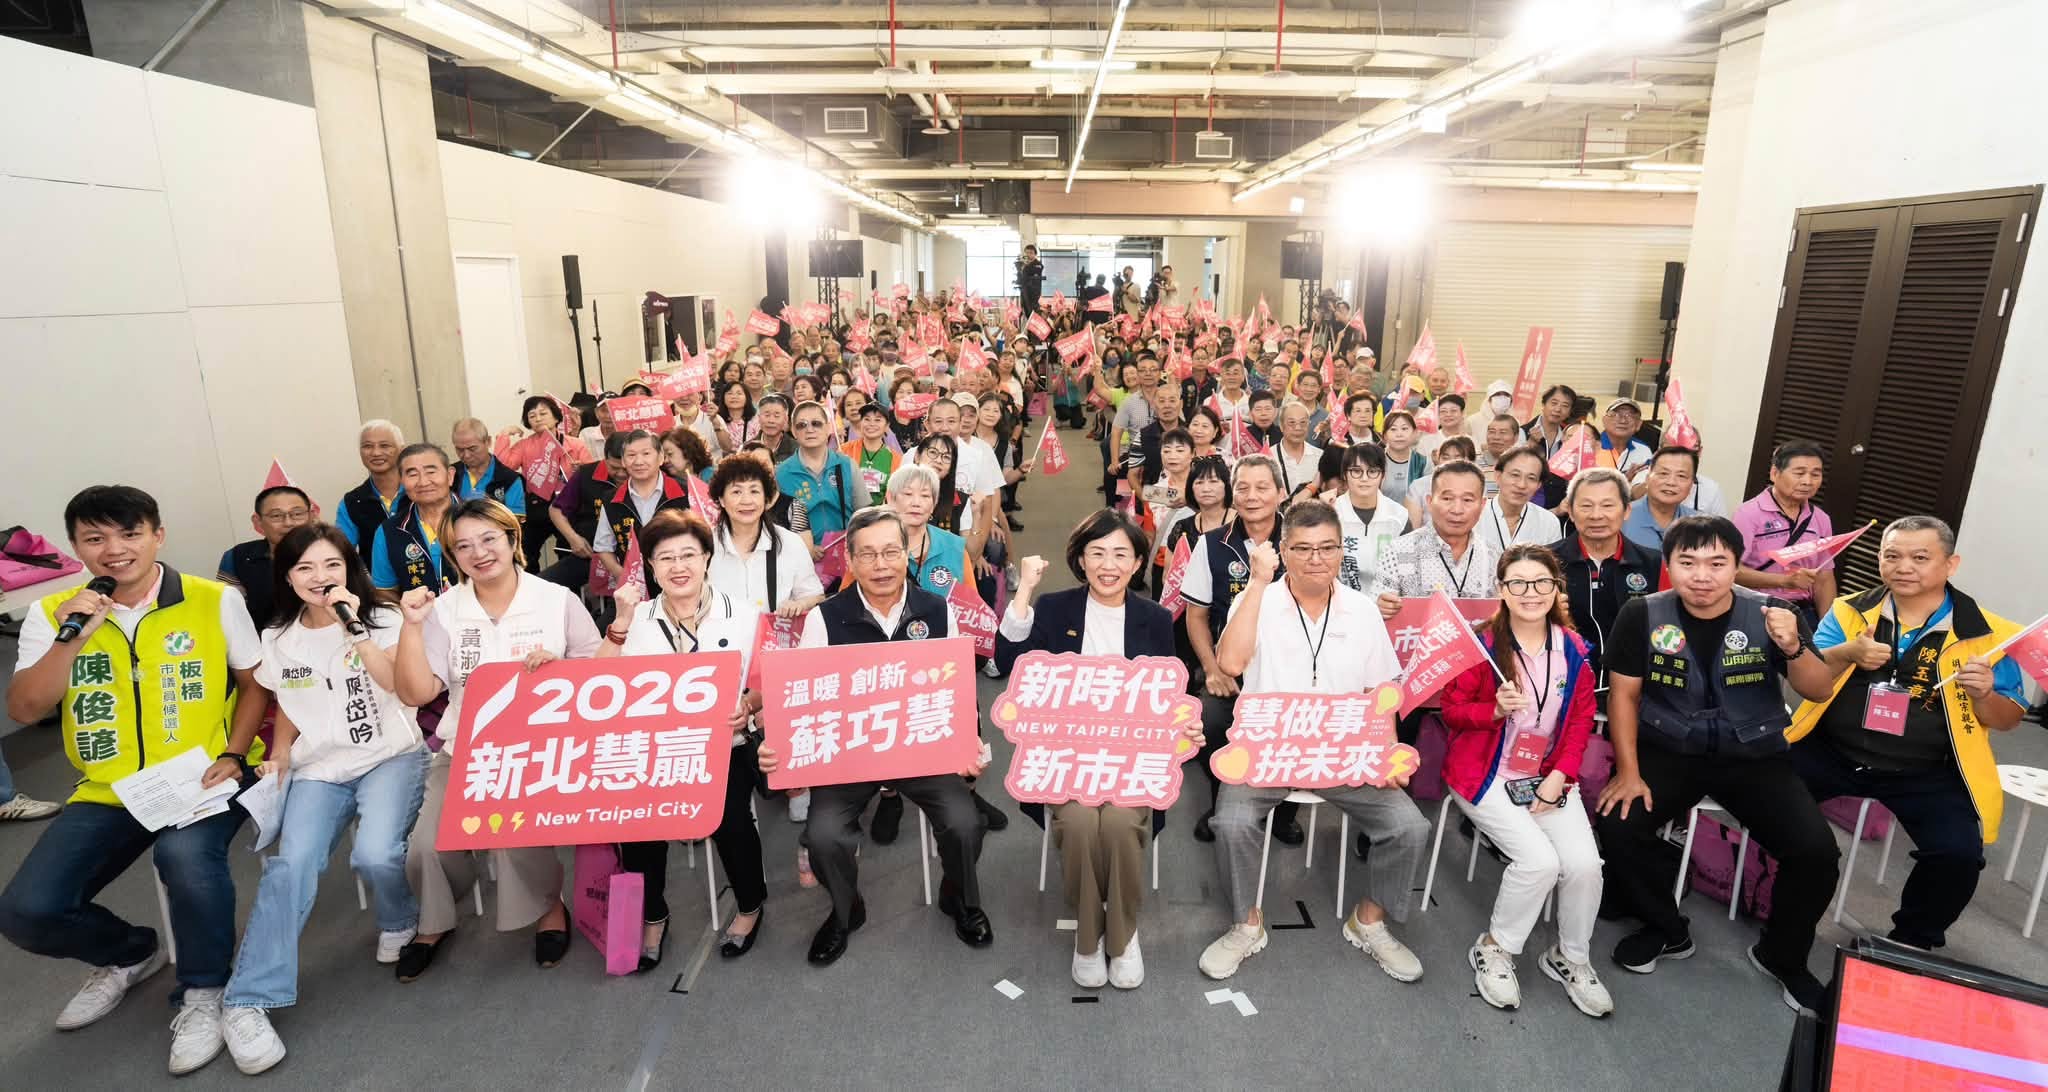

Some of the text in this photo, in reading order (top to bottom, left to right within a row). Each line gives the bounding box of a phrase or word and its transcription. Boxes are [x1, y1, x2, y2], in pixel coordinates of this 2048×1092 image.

[179, 661, 204, 701] 板橋
[281, 666, 312, 680] 陳岱吟
[460, 628, 481, 688] 黃淑
[783, 660, 907, 708] 溫暖 創新
[1906, 646, 1938, 699] 陳玉章
[72, 652, 118, 763] 陳俊諺
[160, 663, 179, 744] 市議員候選人
[345, 675, 373, 744] 陳岱吟
[527, 666, 718, 725] 2026
[1015, 661, 1177, 716] 新時代
[787, 688, 954, 770] 蘇巧慧
[1015, 722, 1179, 740] NEW TAIPEI CITY
[1233, 697, 1371, 742] 慧做事
[463, 727, 713, 801] 新北慧贏
[1016, 746, 1173, 800] 新市長
[1251, 741, 1386, 784] 拚未來
[535, 802, 702, 827] New Taipei City
